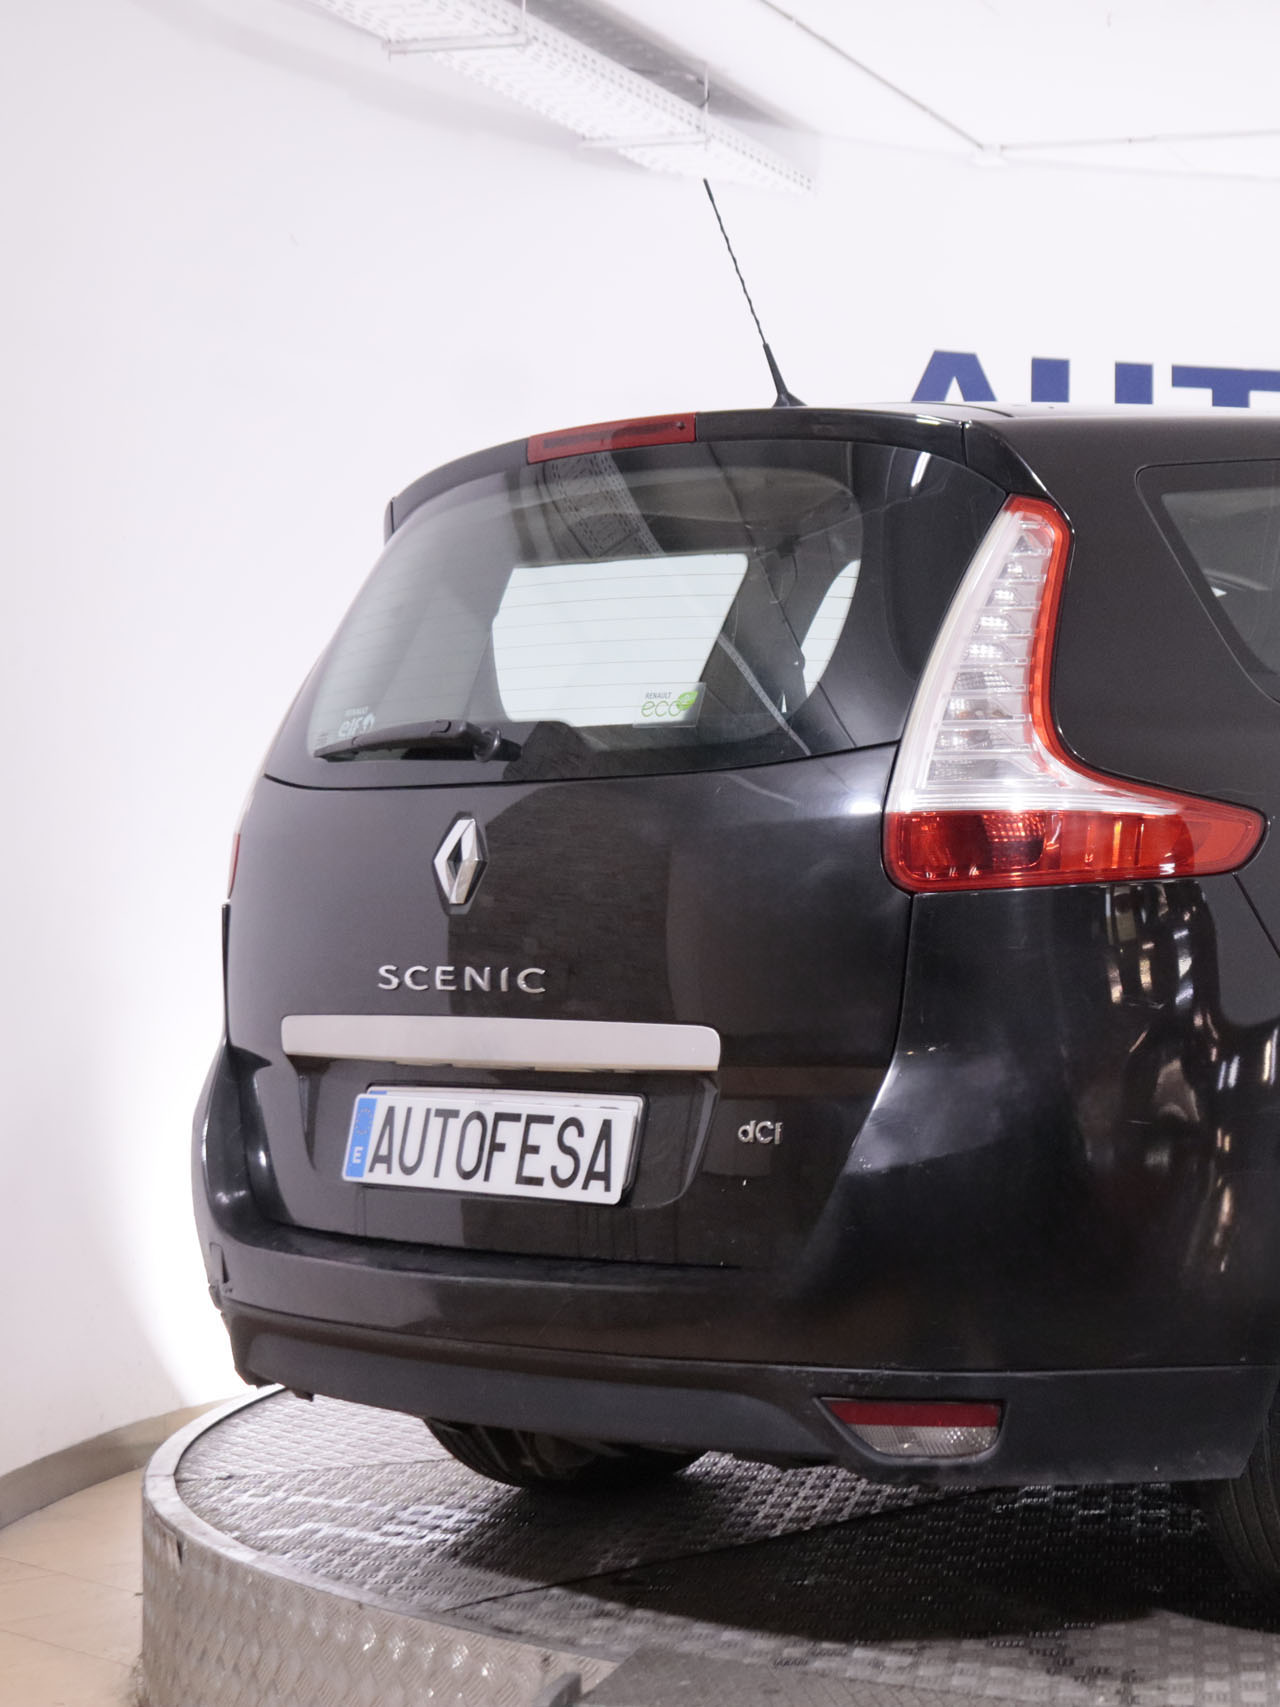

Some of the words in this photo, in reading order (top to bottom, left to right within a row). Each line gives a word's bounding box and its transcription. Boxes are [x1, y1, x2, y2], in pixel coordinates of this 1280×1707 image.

[641, 700, 681, 717] eco
[377, 964, 547, 994] SCENIC
[352, 1146, 363, 1165] E
[367, 1105, 613, 1193] AUTOFESA
